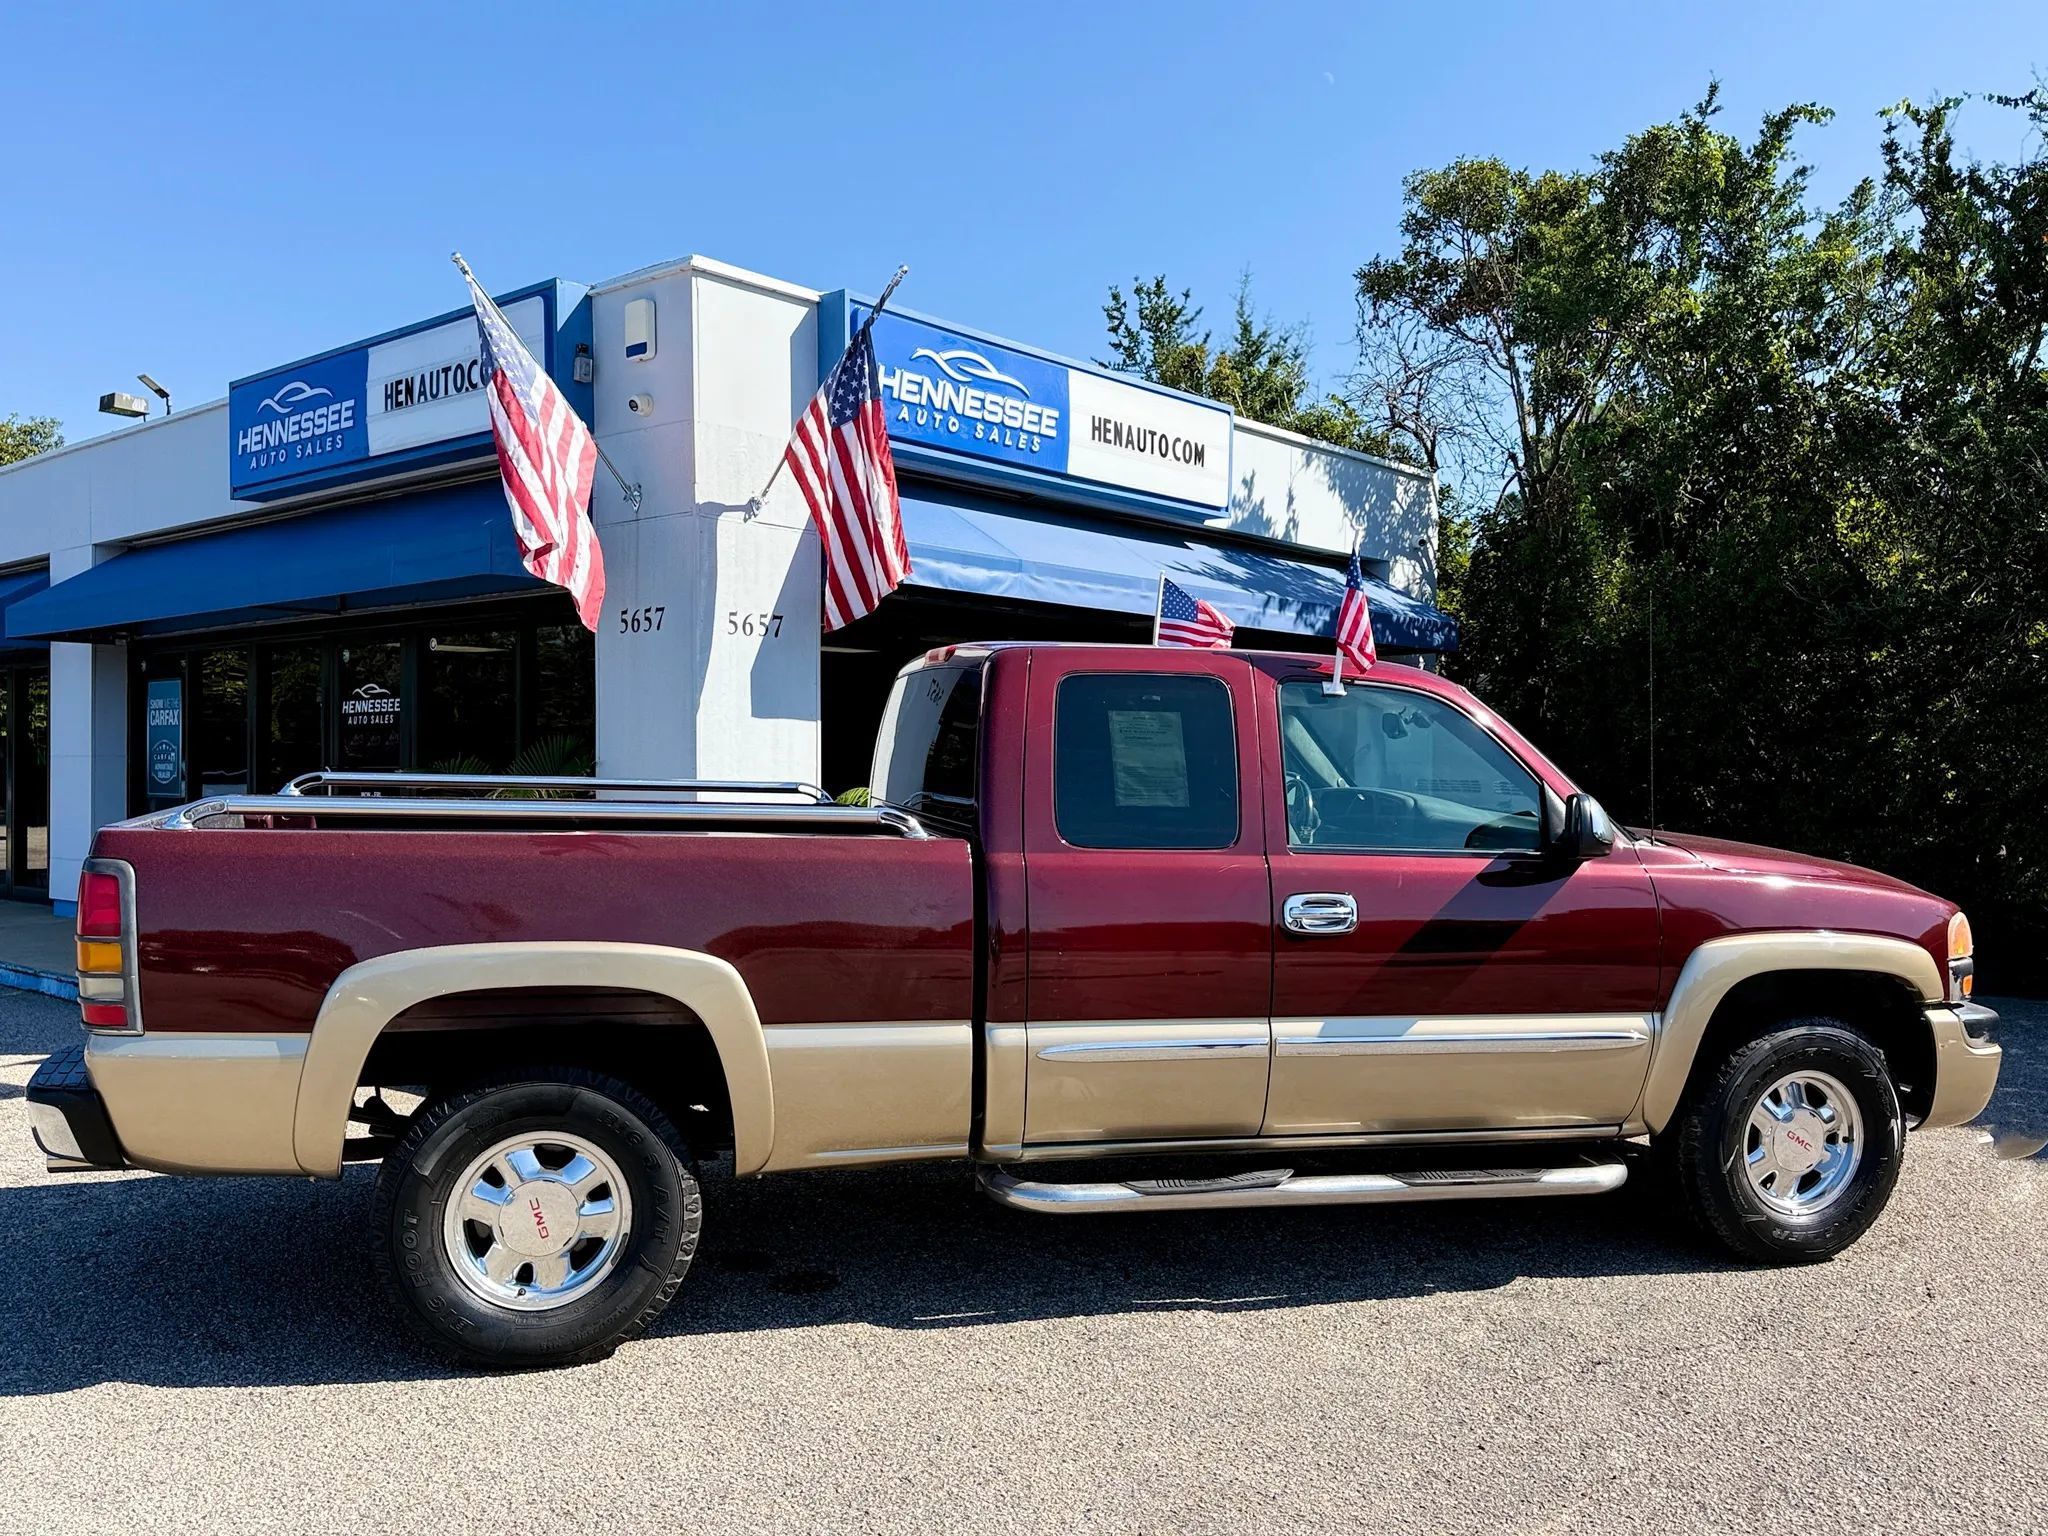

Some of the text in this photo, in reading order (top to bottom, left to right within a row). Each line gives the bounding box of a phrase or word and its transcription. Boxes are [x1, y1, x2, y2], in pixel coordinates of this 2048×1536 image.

[384, 358, 487, 411] HENAUTO.C
[878, 364, 1060, 438] HENNESSEE
[238, 399, 355, 455] HENNESSEE
[898, 404, 1041, 452] AUTO SALES
[1091, 415, 1206, 467] HENAUTO.COM
[250, 434, 343, 469] AUTO SALES
[620, 606, 666, 634] 5657
[728, 611, 784, 638] 5657
[150, 709, 179, 726] CARFAX
[342, 698, 400, 714] HENNESSEE
[347, 714, 394, 725] AUTO SALES
[1787, 1130, 1813, 1152] GMC
[529, 1196, 549, 1240] GMC
[404, 1209, 430, 1289] FOOT
